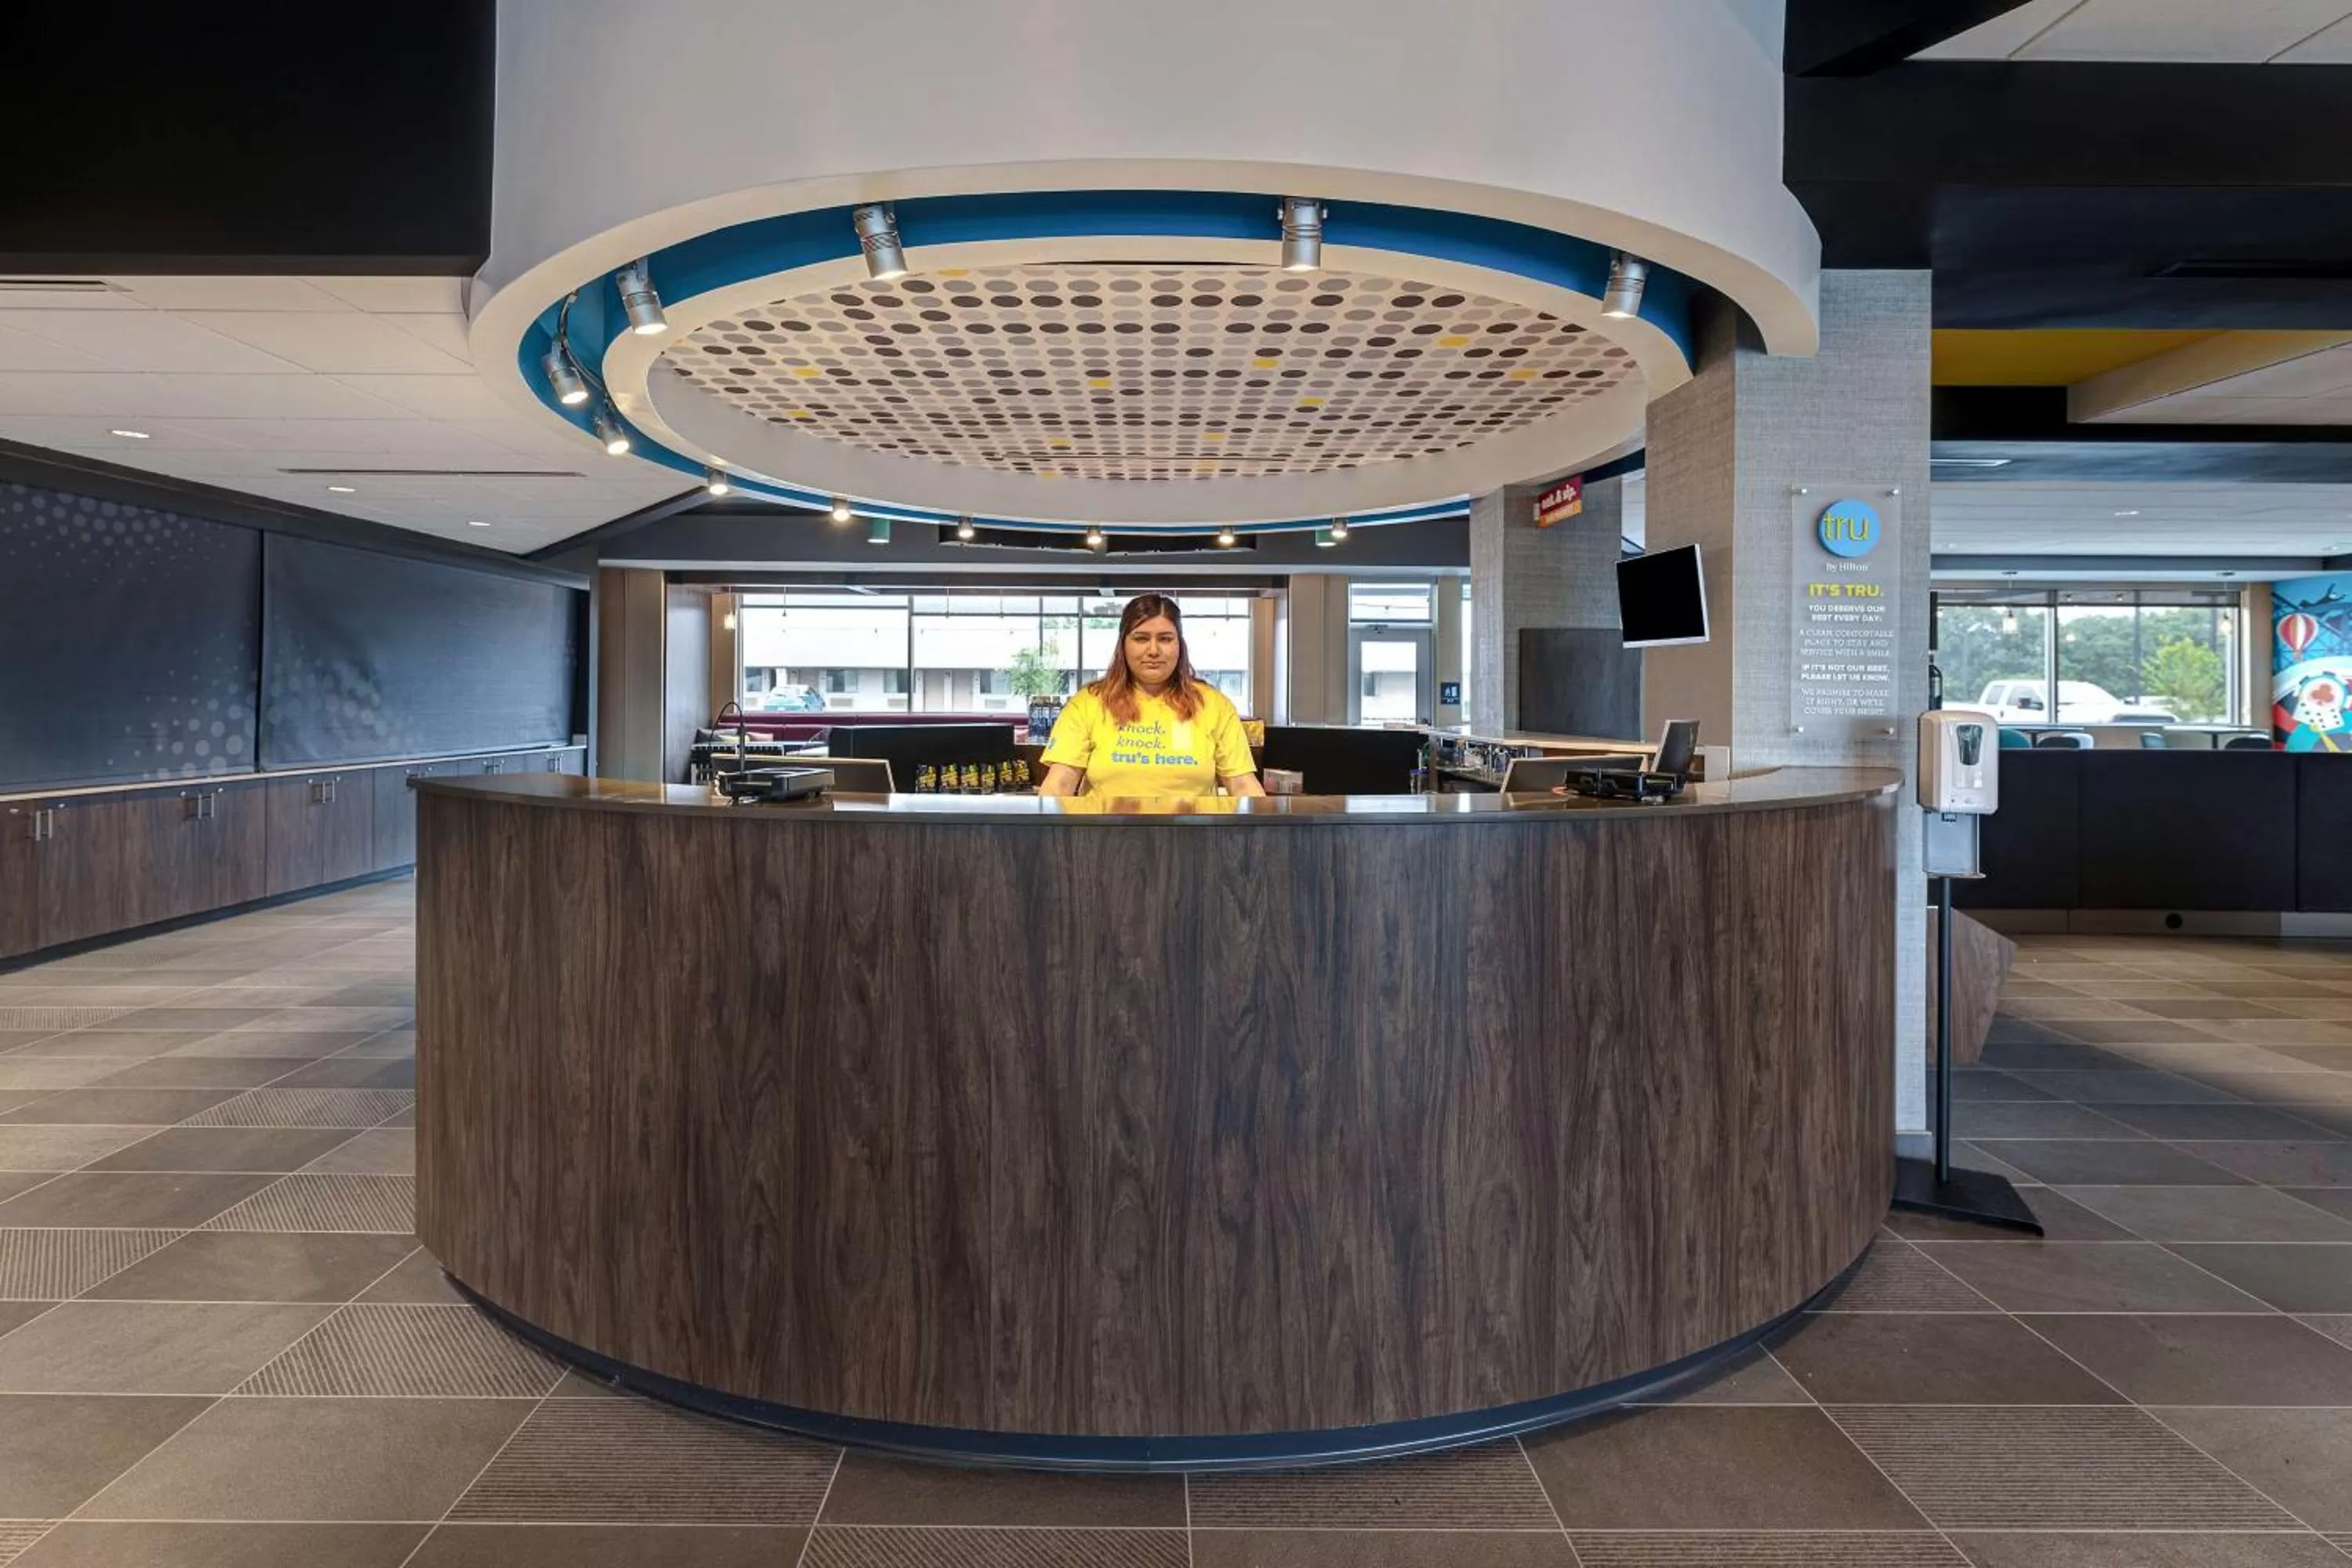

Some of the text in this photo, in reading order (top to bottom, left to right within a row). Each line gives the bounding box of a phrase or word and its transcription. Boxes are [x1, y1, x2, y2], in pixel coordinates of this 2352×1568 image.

[1823, 512, 1870, 540] tru
[1826, 561, 1868, 573] by Hilton
[1809, 583, 1885, 597] IT'S TRU.
[1809, 604, 1886, 613] YOU DESERVE OUR
[1835, 648, 1858, 657] WITH
[1116, 735, 1166, 750] knock.
[1111, 752, 1198, 765] tru's here.
